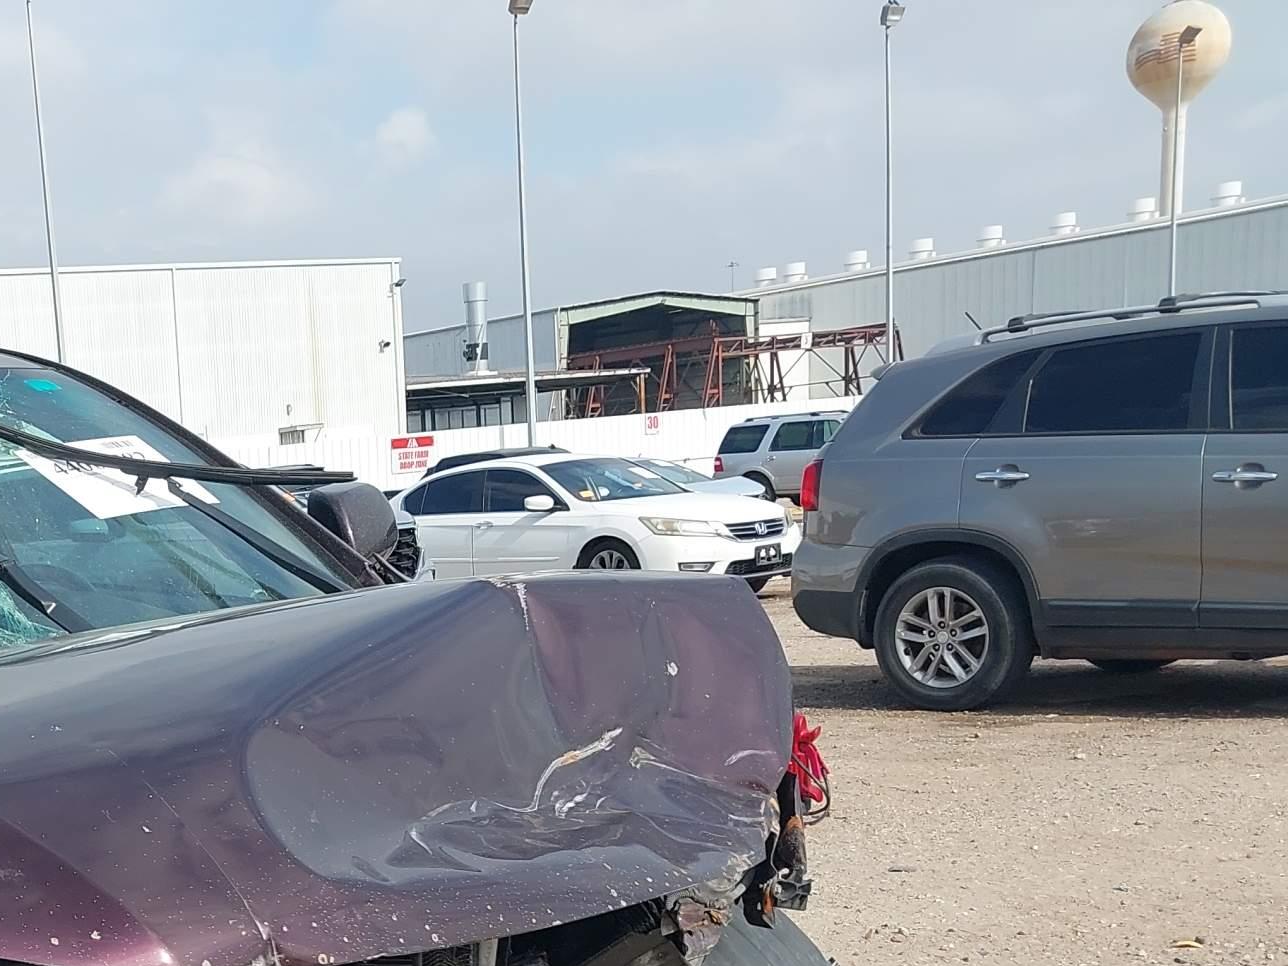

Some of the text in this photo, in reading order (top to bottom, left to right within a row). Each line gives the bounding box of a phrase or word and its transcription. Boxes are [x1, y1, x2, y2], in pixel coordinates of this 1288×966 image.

[647, 415, 658, 429] 30
[398, 450, 429, 461] STATE FARM
[400, 460, 428, 470] DROP ZONE
